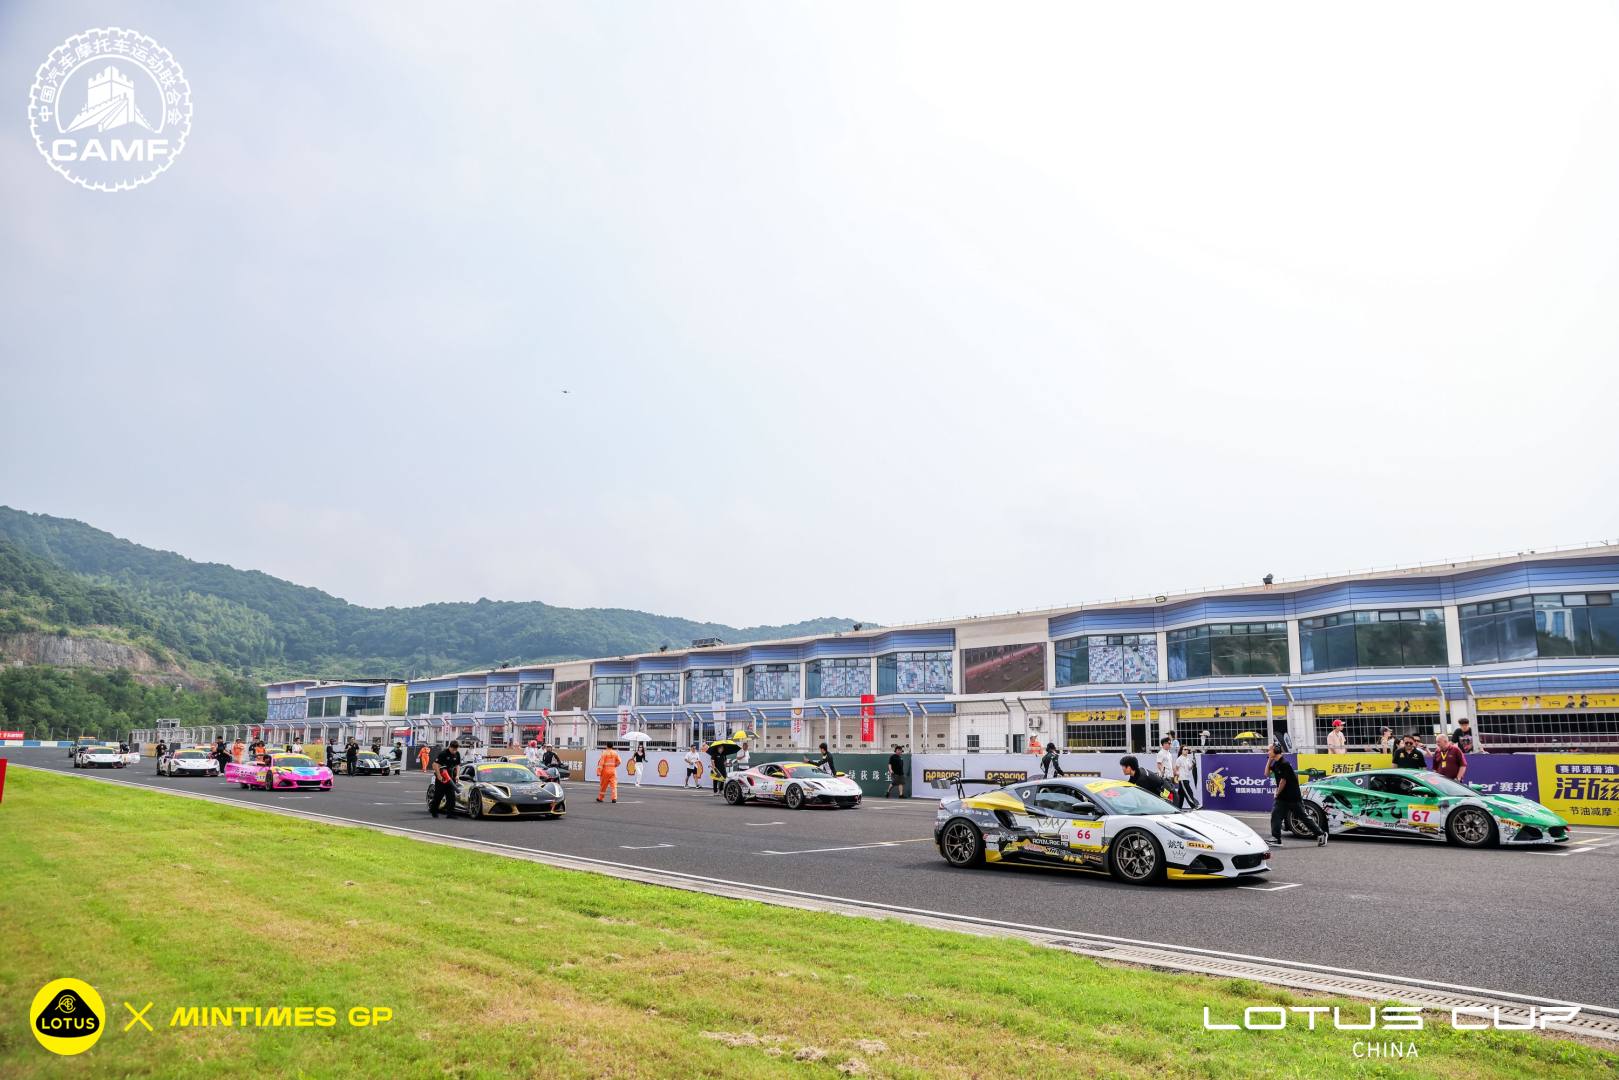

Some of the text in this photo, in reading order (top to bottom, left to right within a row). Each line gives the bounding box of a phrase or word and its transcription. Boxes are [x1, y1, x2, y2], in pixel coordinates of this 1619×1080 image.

[1559, 765, 1615, 774] 赛邦润滑油
[1230, 776, 1265, 786] Sober
[1499, 781, 1529, 792] 赛邦
[1569, 806, 1613, 816] 节油减摩
[1411, 810, 1431, 823] 67
[1077, 830, 1091, 840] 66
